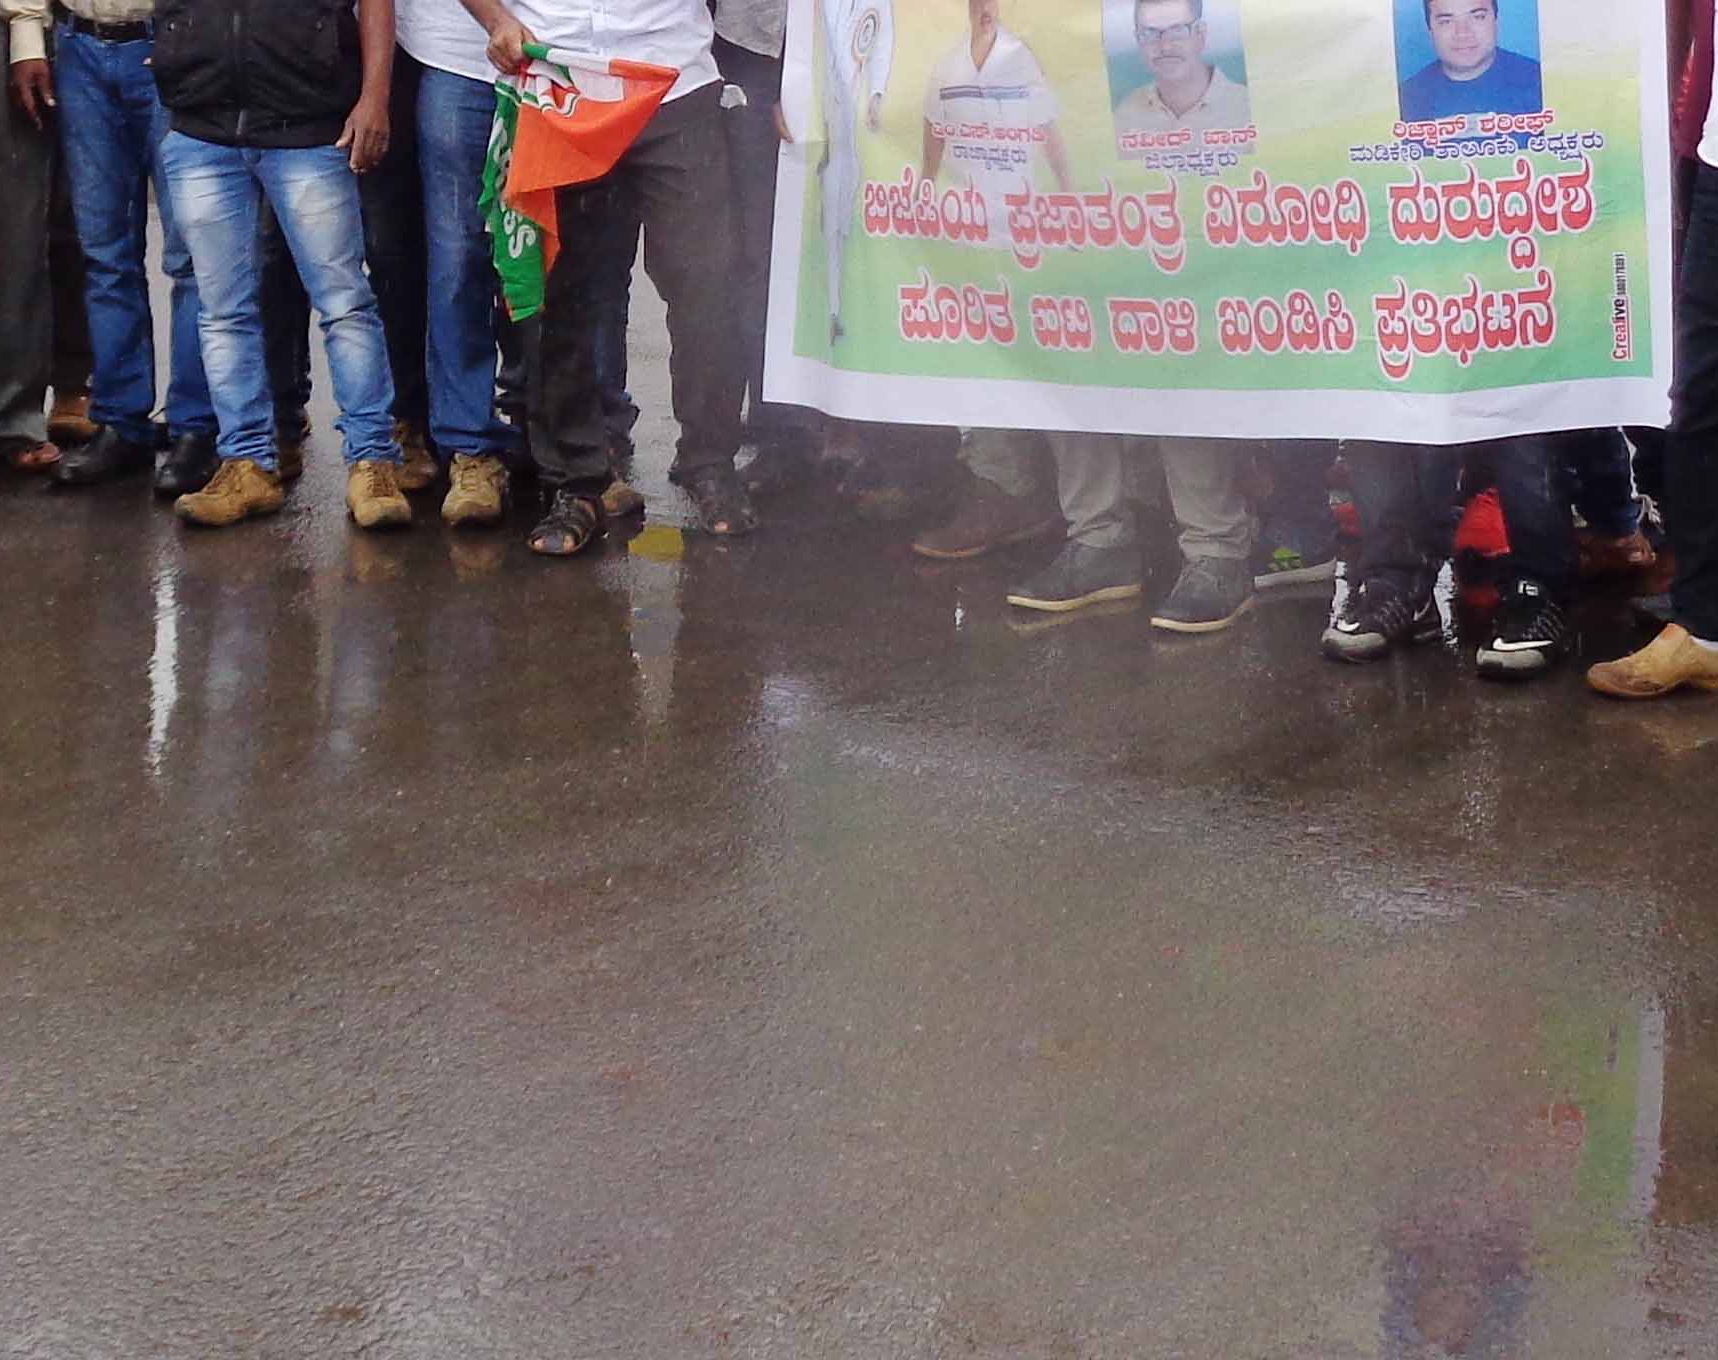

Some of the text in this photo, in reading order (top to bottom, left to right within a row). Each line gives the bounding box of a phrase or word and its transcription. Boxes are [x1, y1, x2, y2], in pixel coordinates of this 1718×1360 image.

[863, 156, 1594, 274] ಬಿಜೆಪಿಯ ಪ್ರಜಾತಂತ್ರ ವಿರೋಧಿ ದುರುದ್ದೇಶ
[898, 266, 1018, 346] ಪೂರಿತ
[1031, 294, 1094, 351] ಐಟಿ
[1106, 295, 1198, 355] ದಾಳಿ
[1218, 290, 1357, 355] ಖಂಡಿಸಿ
[1375, 268, 1557, 382] ಪ್ರತಿಭಟನೆ
